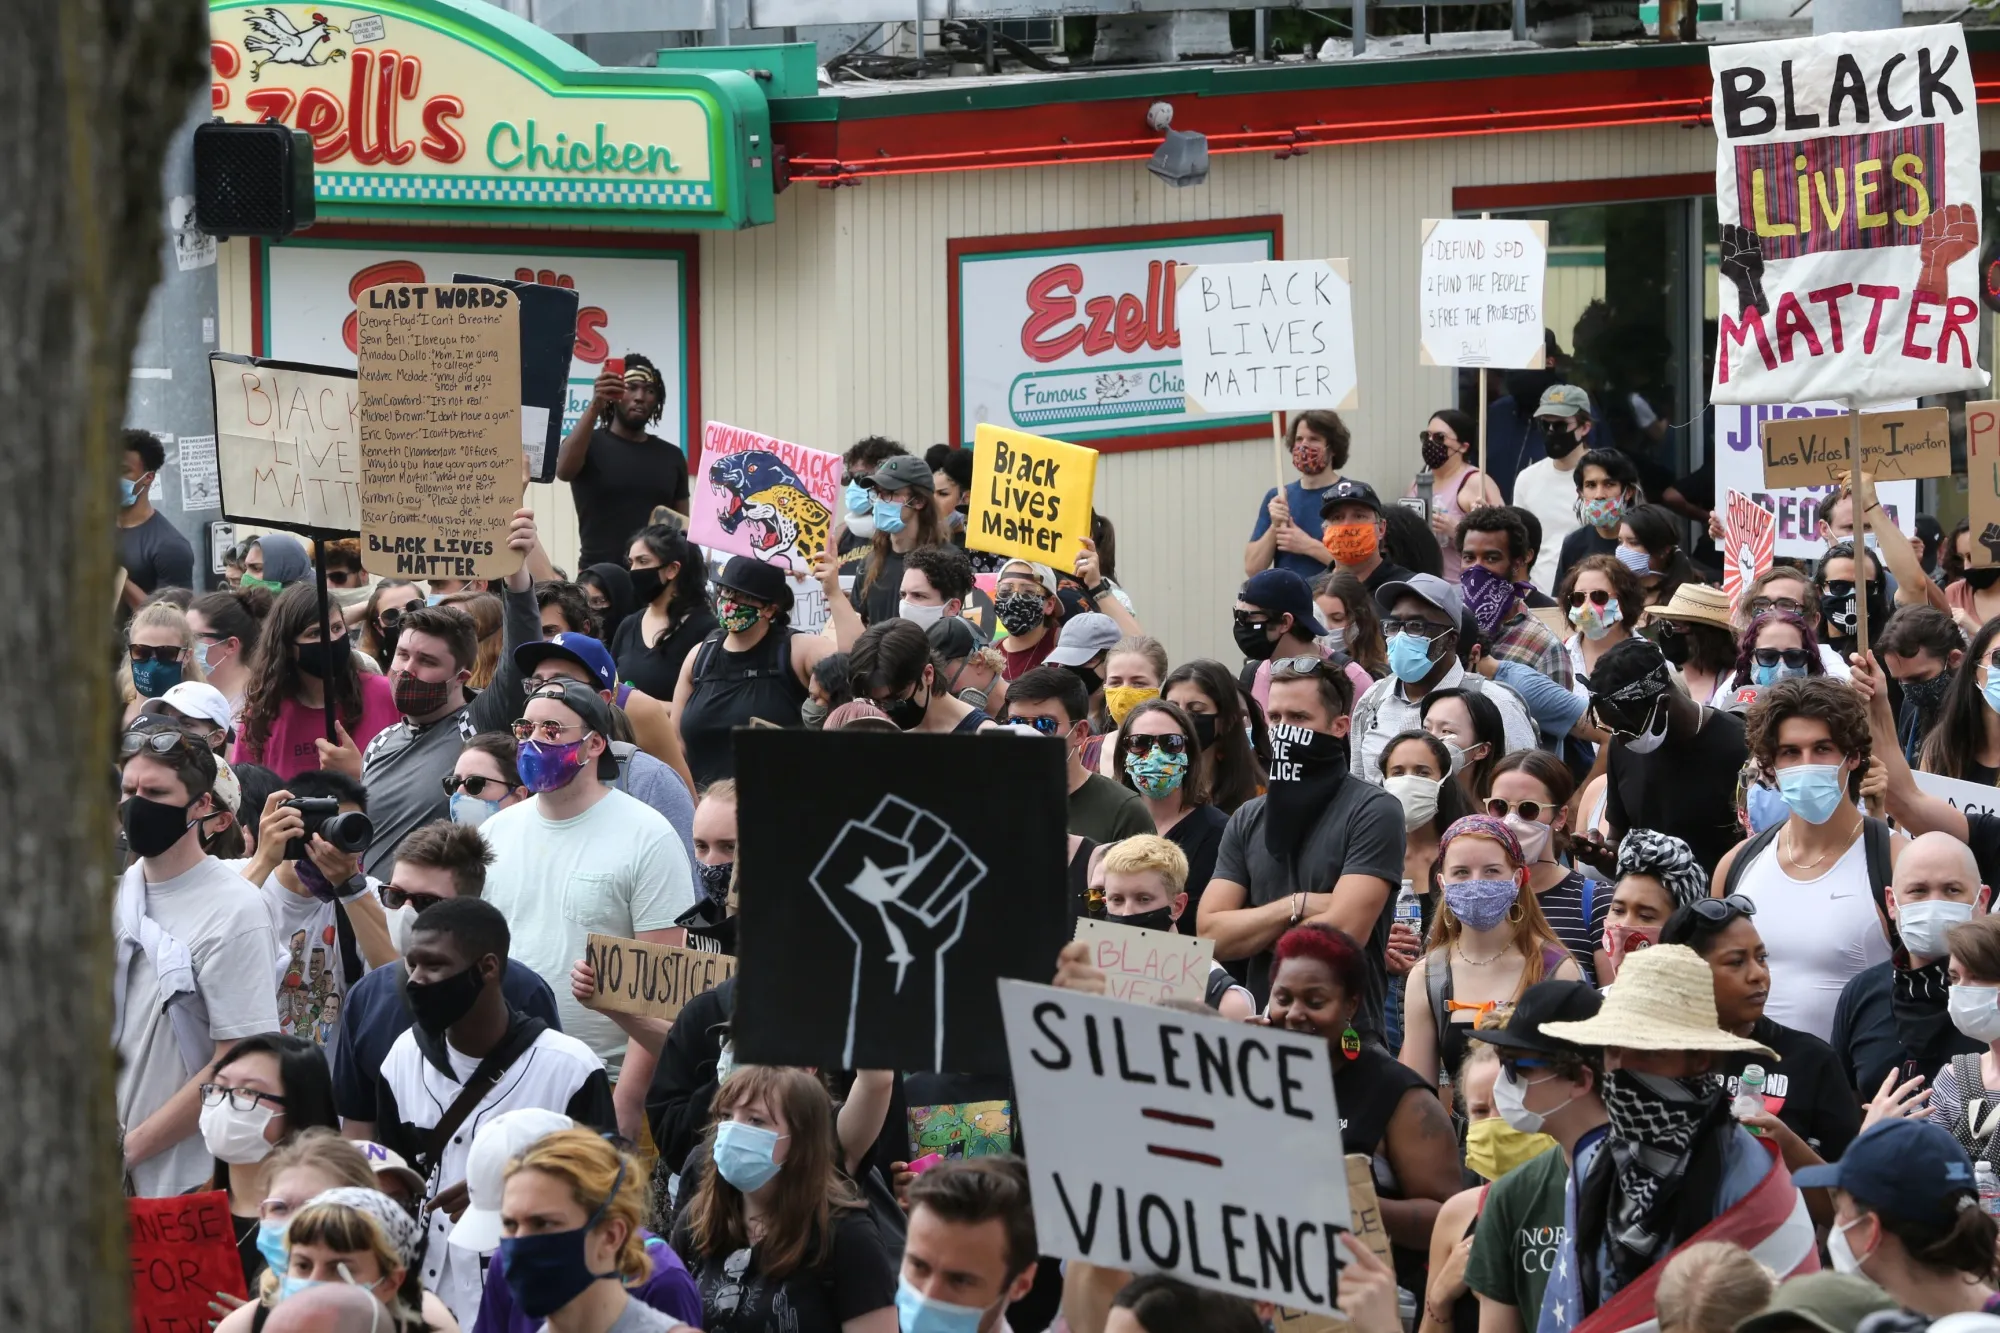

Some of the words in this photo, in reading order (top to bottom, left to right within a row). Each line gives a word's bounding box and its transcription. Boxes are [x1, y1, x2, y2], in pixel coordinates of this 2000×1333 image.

[1720, 45, 1963, 138] BLACK
[486, 118, 680, 174] Chicken
[1437, 239, 1485, 260] DEFUND
[1493, 241, 1524, 259] SPD
[1202, 271, 1332, 312] BLACK
[1437, 274, 1462, 297] FUND
[1465, 274, 1486, 292] THE
[1491, 271, 1530, 294] PEOPLE
[370, 286, 428, 309] LAST
[435, 287, 509, 309] WORDS
[359, 311, 391, 333] George
[1438, 307, 1460, 328] FREE
[1464, 307, 1483, 326] THE
[1487, 304, 1536, 325] PROTESTERS
[360, 329, 382, 345] Sean
[1207, 319, 1326, 356] LIVES
[1718, 282, 1979, 384] MATTER
[360, 346, 397, 361] Amadou
[476, 350, 499, 362] going
[431, 361, 442, 370] to
[457, 372, 472, 382] did
[475, 375, 492, 386] you
[1204, 365, 1332, 397] MATTER
[360, 391, 382, 407] John
[448, 395, 464, 406] not
[1023, 383, 1087, 406] Famous
[360, 409, 393, 423] Michael
[460, 411, 481, 422] have
[360, 425, 382, 441] Eric
[360, 444, 401, 458] Kenneth
[704, 425, 765, 455] CHICANOS
[766, 438, 780, 452] 4
[781, 443, 840, 483] BLACK
[1767, 437, 1799, 467] Las
[1798, 434, 1843, 466] Vidas
[388, 458, 399, 469] do
[400, 460, 418, 473] you
[423, 458, 443, 470] have
[445, 460, 465, 473] your
[993, 440, 1060, 489] Black
[475, 473, 496, 484] you
[990, 475, 1060, 522] Lives
[361, 508, 389, 523] Oscar
[982, 510, 1063, 553] Matter
[368, 533, 427, 555] BLACK
[433, 538, 493, 556] LIVES
[396, 554, 480, 578] MATTER.
[1735, 689, 1758, 704] R
[585, 943, 623, 995] NO
[1097, 939, 1204, 990] BLACK
[1030, 1001, 1314, 1121] SILENCE
[1051, 1171, 1352, 1310] VIOLENCE
